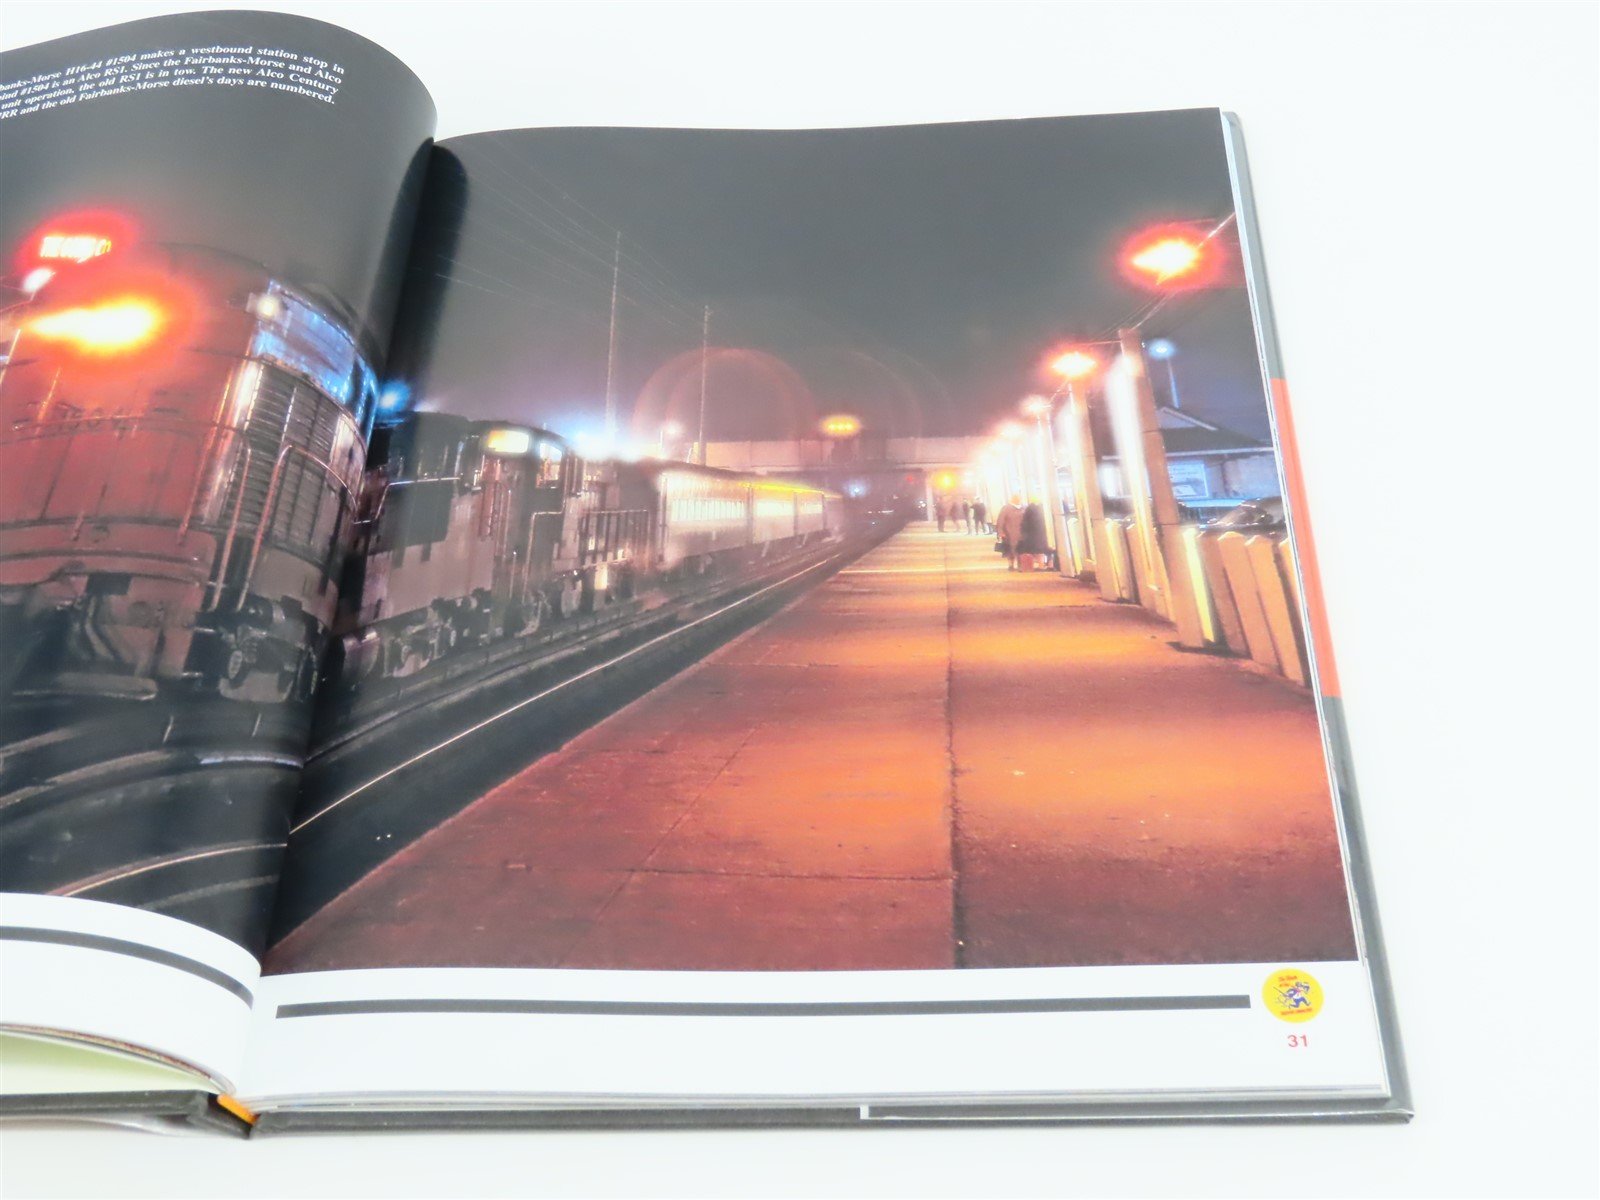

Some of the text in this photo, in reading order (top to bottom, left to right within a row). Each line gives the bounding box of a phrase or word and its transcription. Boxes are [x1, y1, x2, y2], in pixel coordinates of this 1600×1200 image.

[20, 82, 50, 96] #1504
[51, 80, 61, 89] is
[62, 78, 75, 86] an
[77, 72, 101, 83] Alco
[104, 66, 128, 77] RS1.
[130, 61, 161, 72] Since
[163, 58, 181, 67] the
[184, 56, 286, 69] Fairbanks-Morse
[288, 64, 312, 75] and
[314, 70, 342, 85] Alco
[66, 60, 102, 76] H16-44
[105, 54, 137, 67] #1504
[140, 50, 174, 61] makes
[191, 45, 253, 54] westbound
[256, 48, 298, 61] station
[302, 55, 328, 69] stop
[332, 63, 345, 75] in
[1, 99, 22, 110] unit
[78, 82, 96, 92] the
[98, 77, 115, 87] old
[120, 72, 141, 84] RS1
[145, 71, 154, 79] is
[158, 69, 170, 77] in
[173, 68, 196, 76] tow.
[202, 65, 224, 75] The
[255, 68, 285, 80] Alco
[289, 73, 339, 95] Century
[20, 103, 40, 115] and
[41, 100, 58, 110] the
[59, 95, 77, 105] old
[78, 80, 170, 102] Fairbanks-Morse
[172, 76, 214, 86] diesel's
[216, 76, 245, 87] days
[246, 80, 268, 88] are
[270, 81, 336, 105] numbered.
[1287, 1034, 1308, 1048] 31
